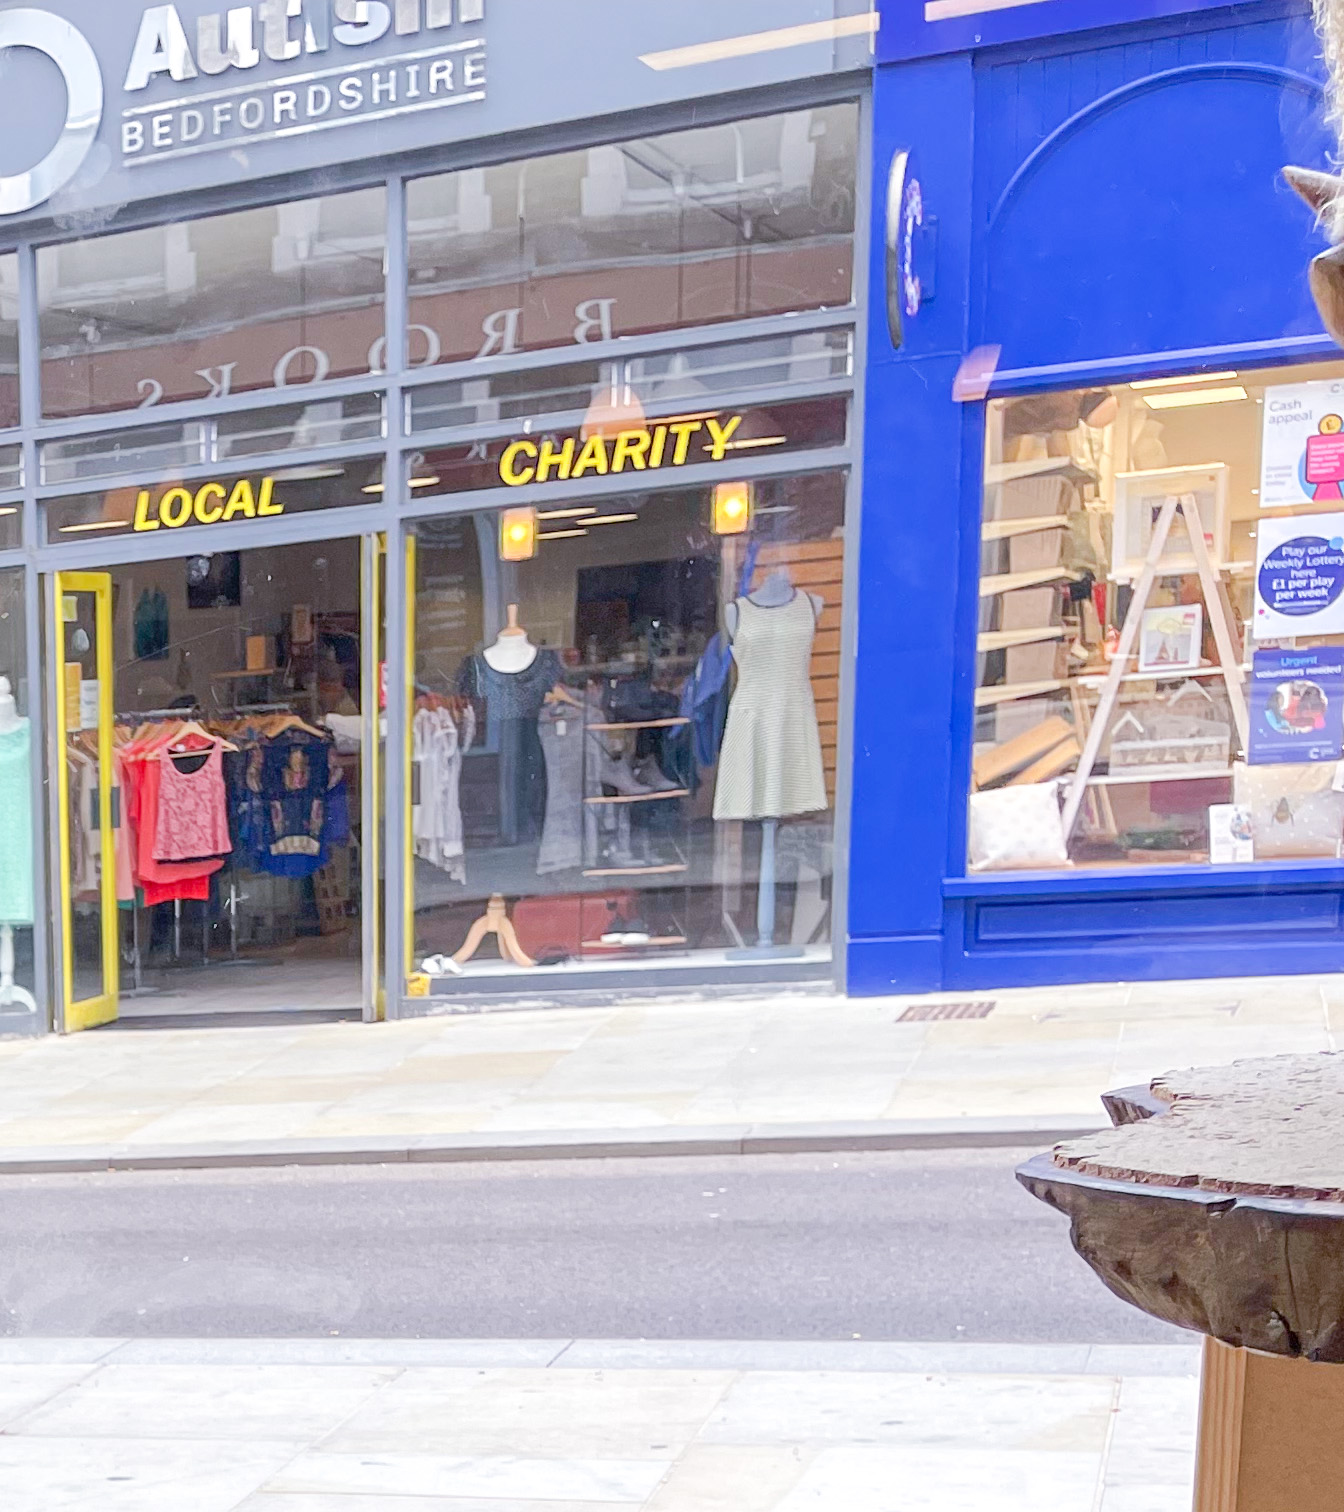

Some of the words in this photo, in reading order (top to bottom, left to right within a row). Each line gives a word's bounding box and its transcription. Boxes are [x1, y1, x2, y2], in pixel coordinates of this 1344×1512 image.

[121, 52, 486, 154] BEDFORDSHIRE
[1269, 400, 1301, 412] Cash
[1269, 410, 1313, 426] appeal
[499, 416, 742, 486] CHARITY
[133, 476, 285, 532] LOCAL
[1263, 558, 1304, 570] Weekly
[1280, 656, 1318, 667] Urgent
